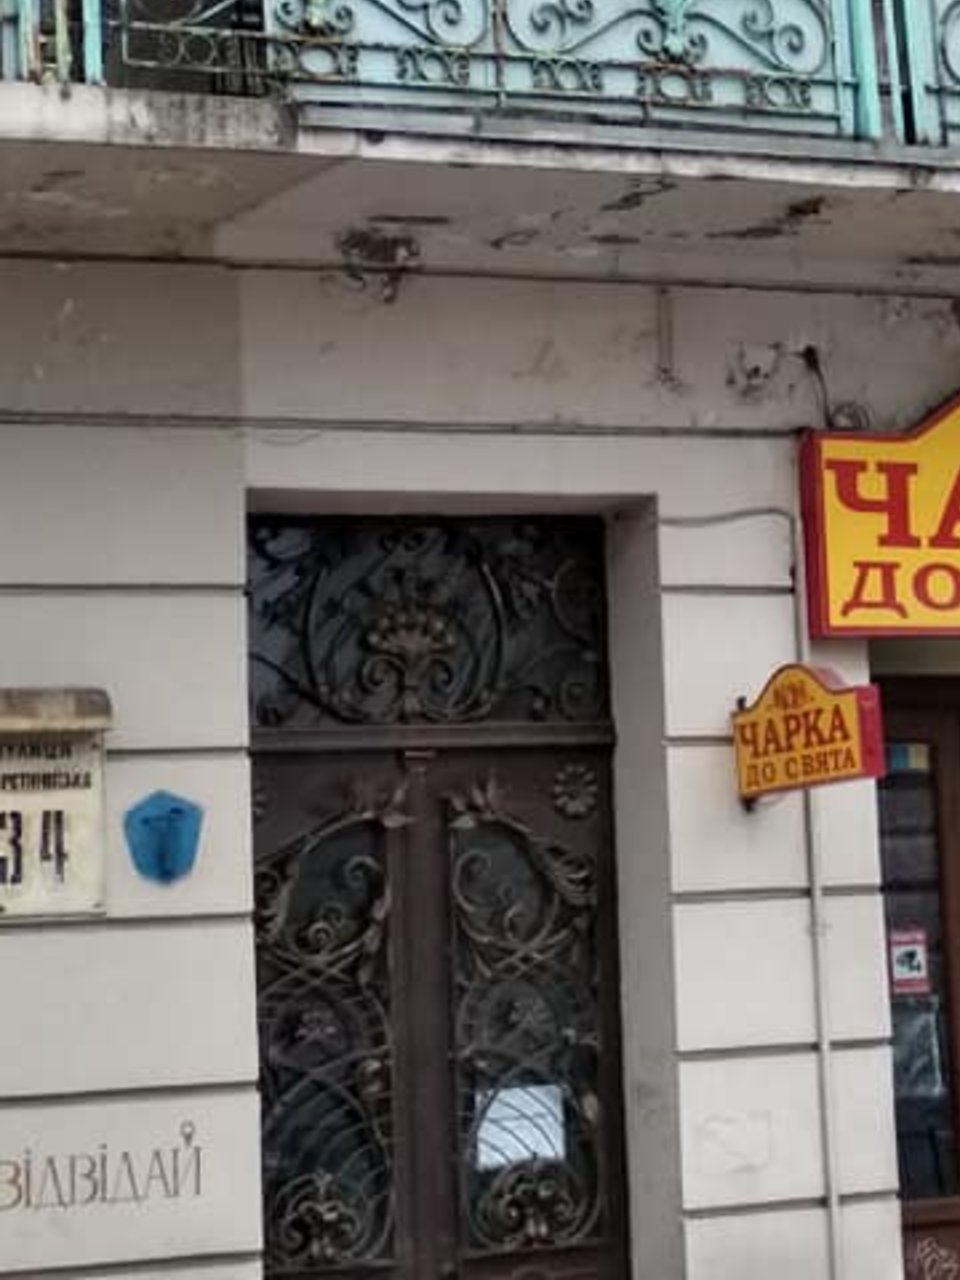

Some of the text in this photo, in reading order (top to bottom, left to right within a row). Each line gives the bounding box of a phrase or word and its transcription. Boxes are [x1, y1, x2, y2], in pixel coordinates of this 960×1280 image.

[739, 704, 851, 759] ЧАРКА
[746, 748, 857, 788] ДО СВЯТА
